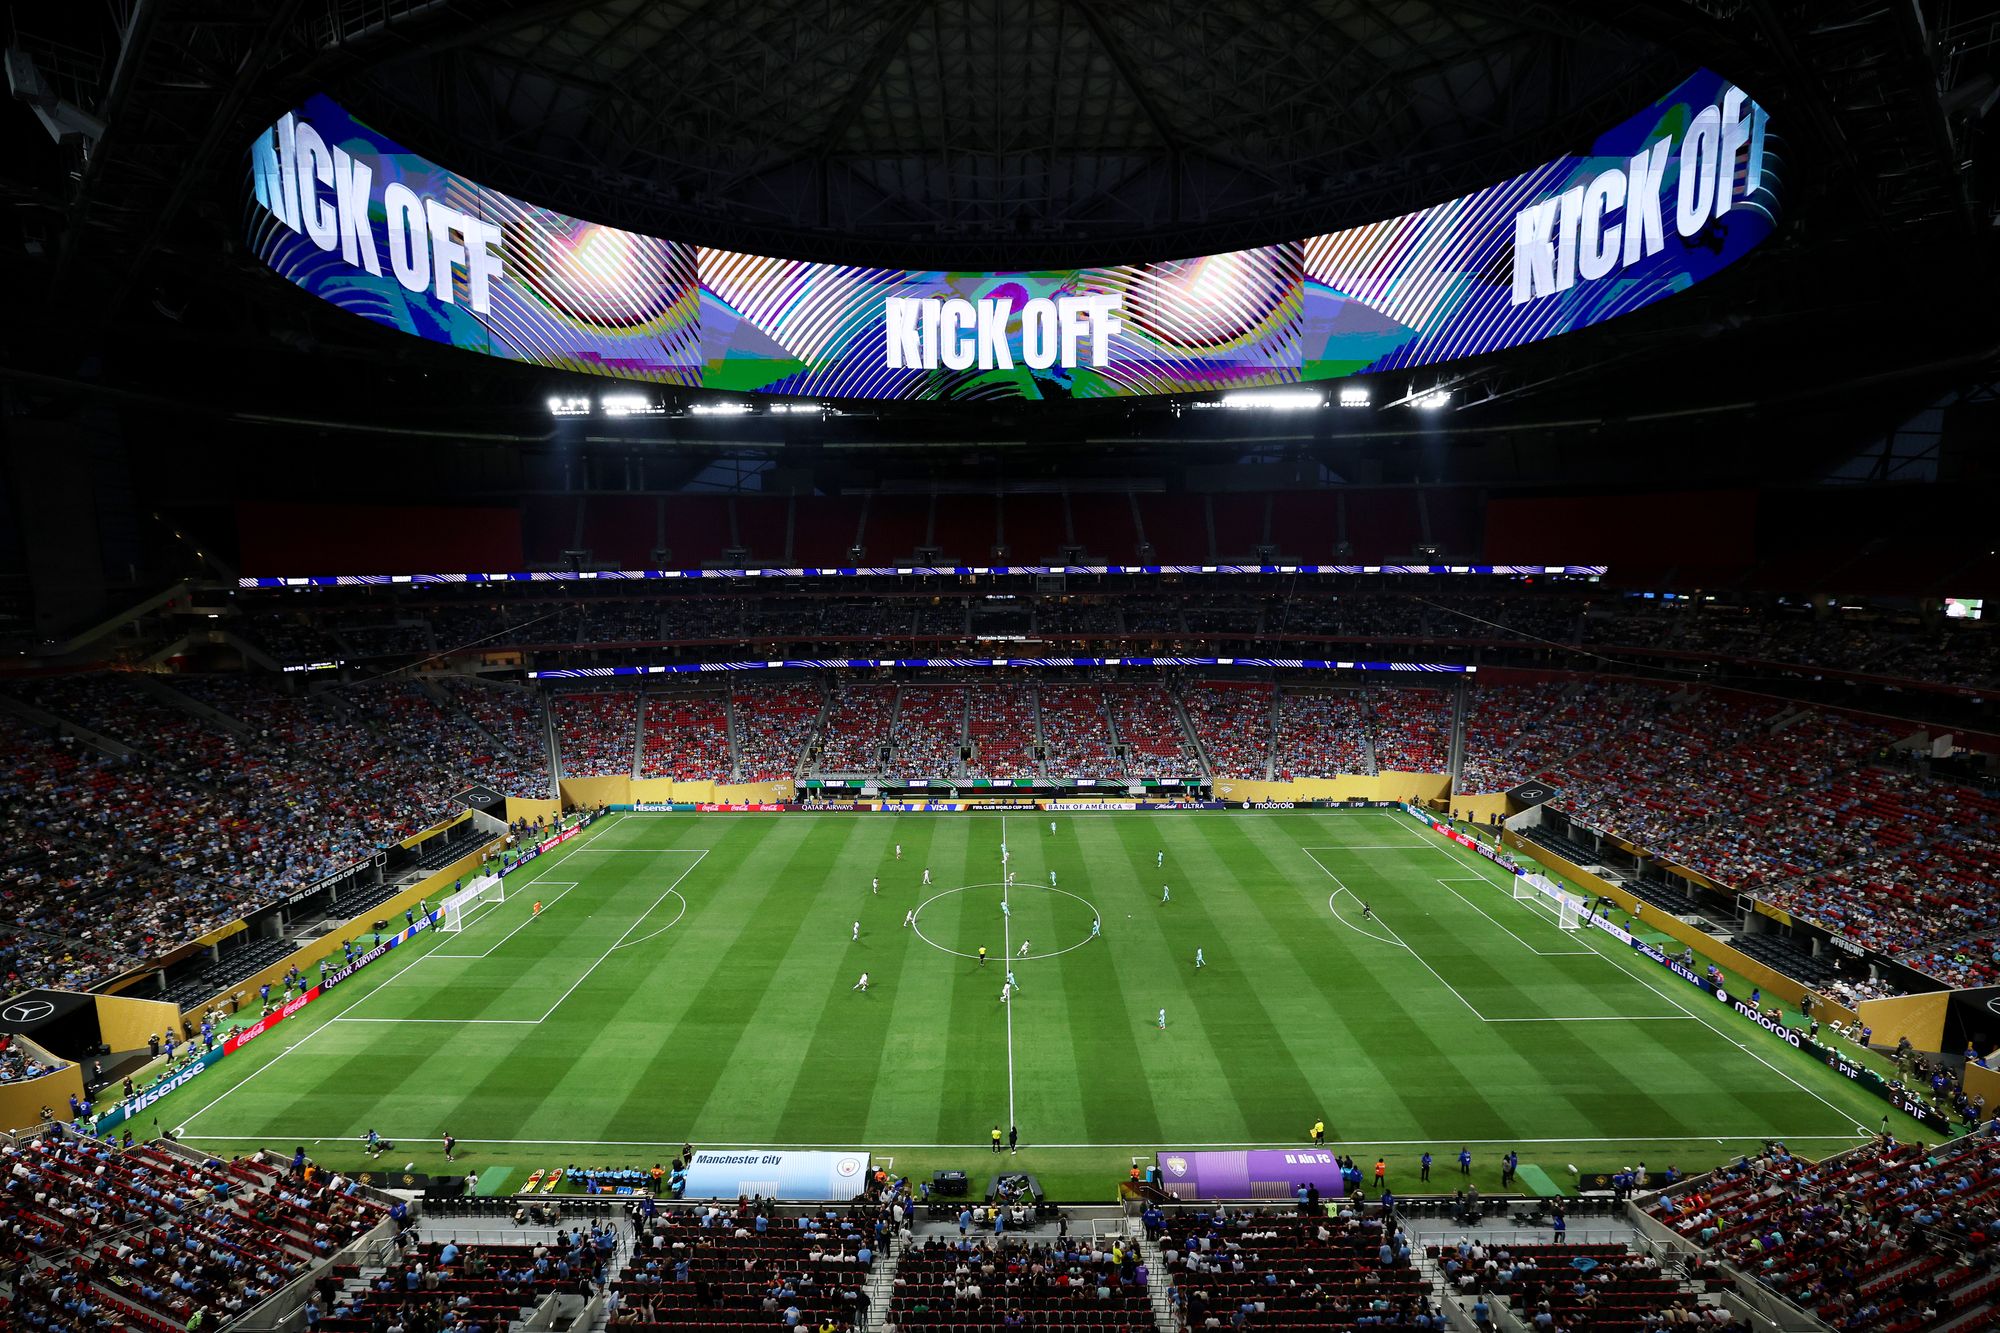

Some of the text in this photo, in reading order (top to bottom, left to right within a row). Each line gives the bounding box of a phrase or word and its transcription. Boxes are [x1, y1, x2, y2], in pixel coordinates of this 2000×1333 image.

[1511, 85, 1770, 307] KICK OFF
[252, 111, 503, 315] KICK OFF
[886, 294, 1122, 370] KICK OFF
[542, 838, 560, 852] Lenovo
[562, 828, 578, 842] Lenovo
[520, 852, 536, 864] ULTRA
[1477, 845, 1514, 872] QATAR AIRWAYS
[289, 893, 304, 904] FIFA
[304, 884, 321, 897] CLUB
[321, 873, 344, 889] WORLD
[344, 868, 356, 878] CUP
[414, 918, 431, 932] VISA
[1594, 916, 1621, 937] AMERICA
[1830, 936, 1865, 958] #FIFACWC
[324, 946, 386, 989] QATAR AIRWAYS
[1670, 962, 1700, 986] ULTRA
[283, 994, 308, 1018] Coca-Cola
[237, 1021, 266, 1047] Coca-Cola
[1734, 1001, 1800, 1048] motorola
[1839, 1062, 1858, 1080] PIF
[124, 1062, 205, 1121] Hisense
[1904, 1102, 1926, 1120] PIF
[696, 1154, 782, 1166] Manchester City
[1285, 1154, 1331, 1164] Al Ain FC
